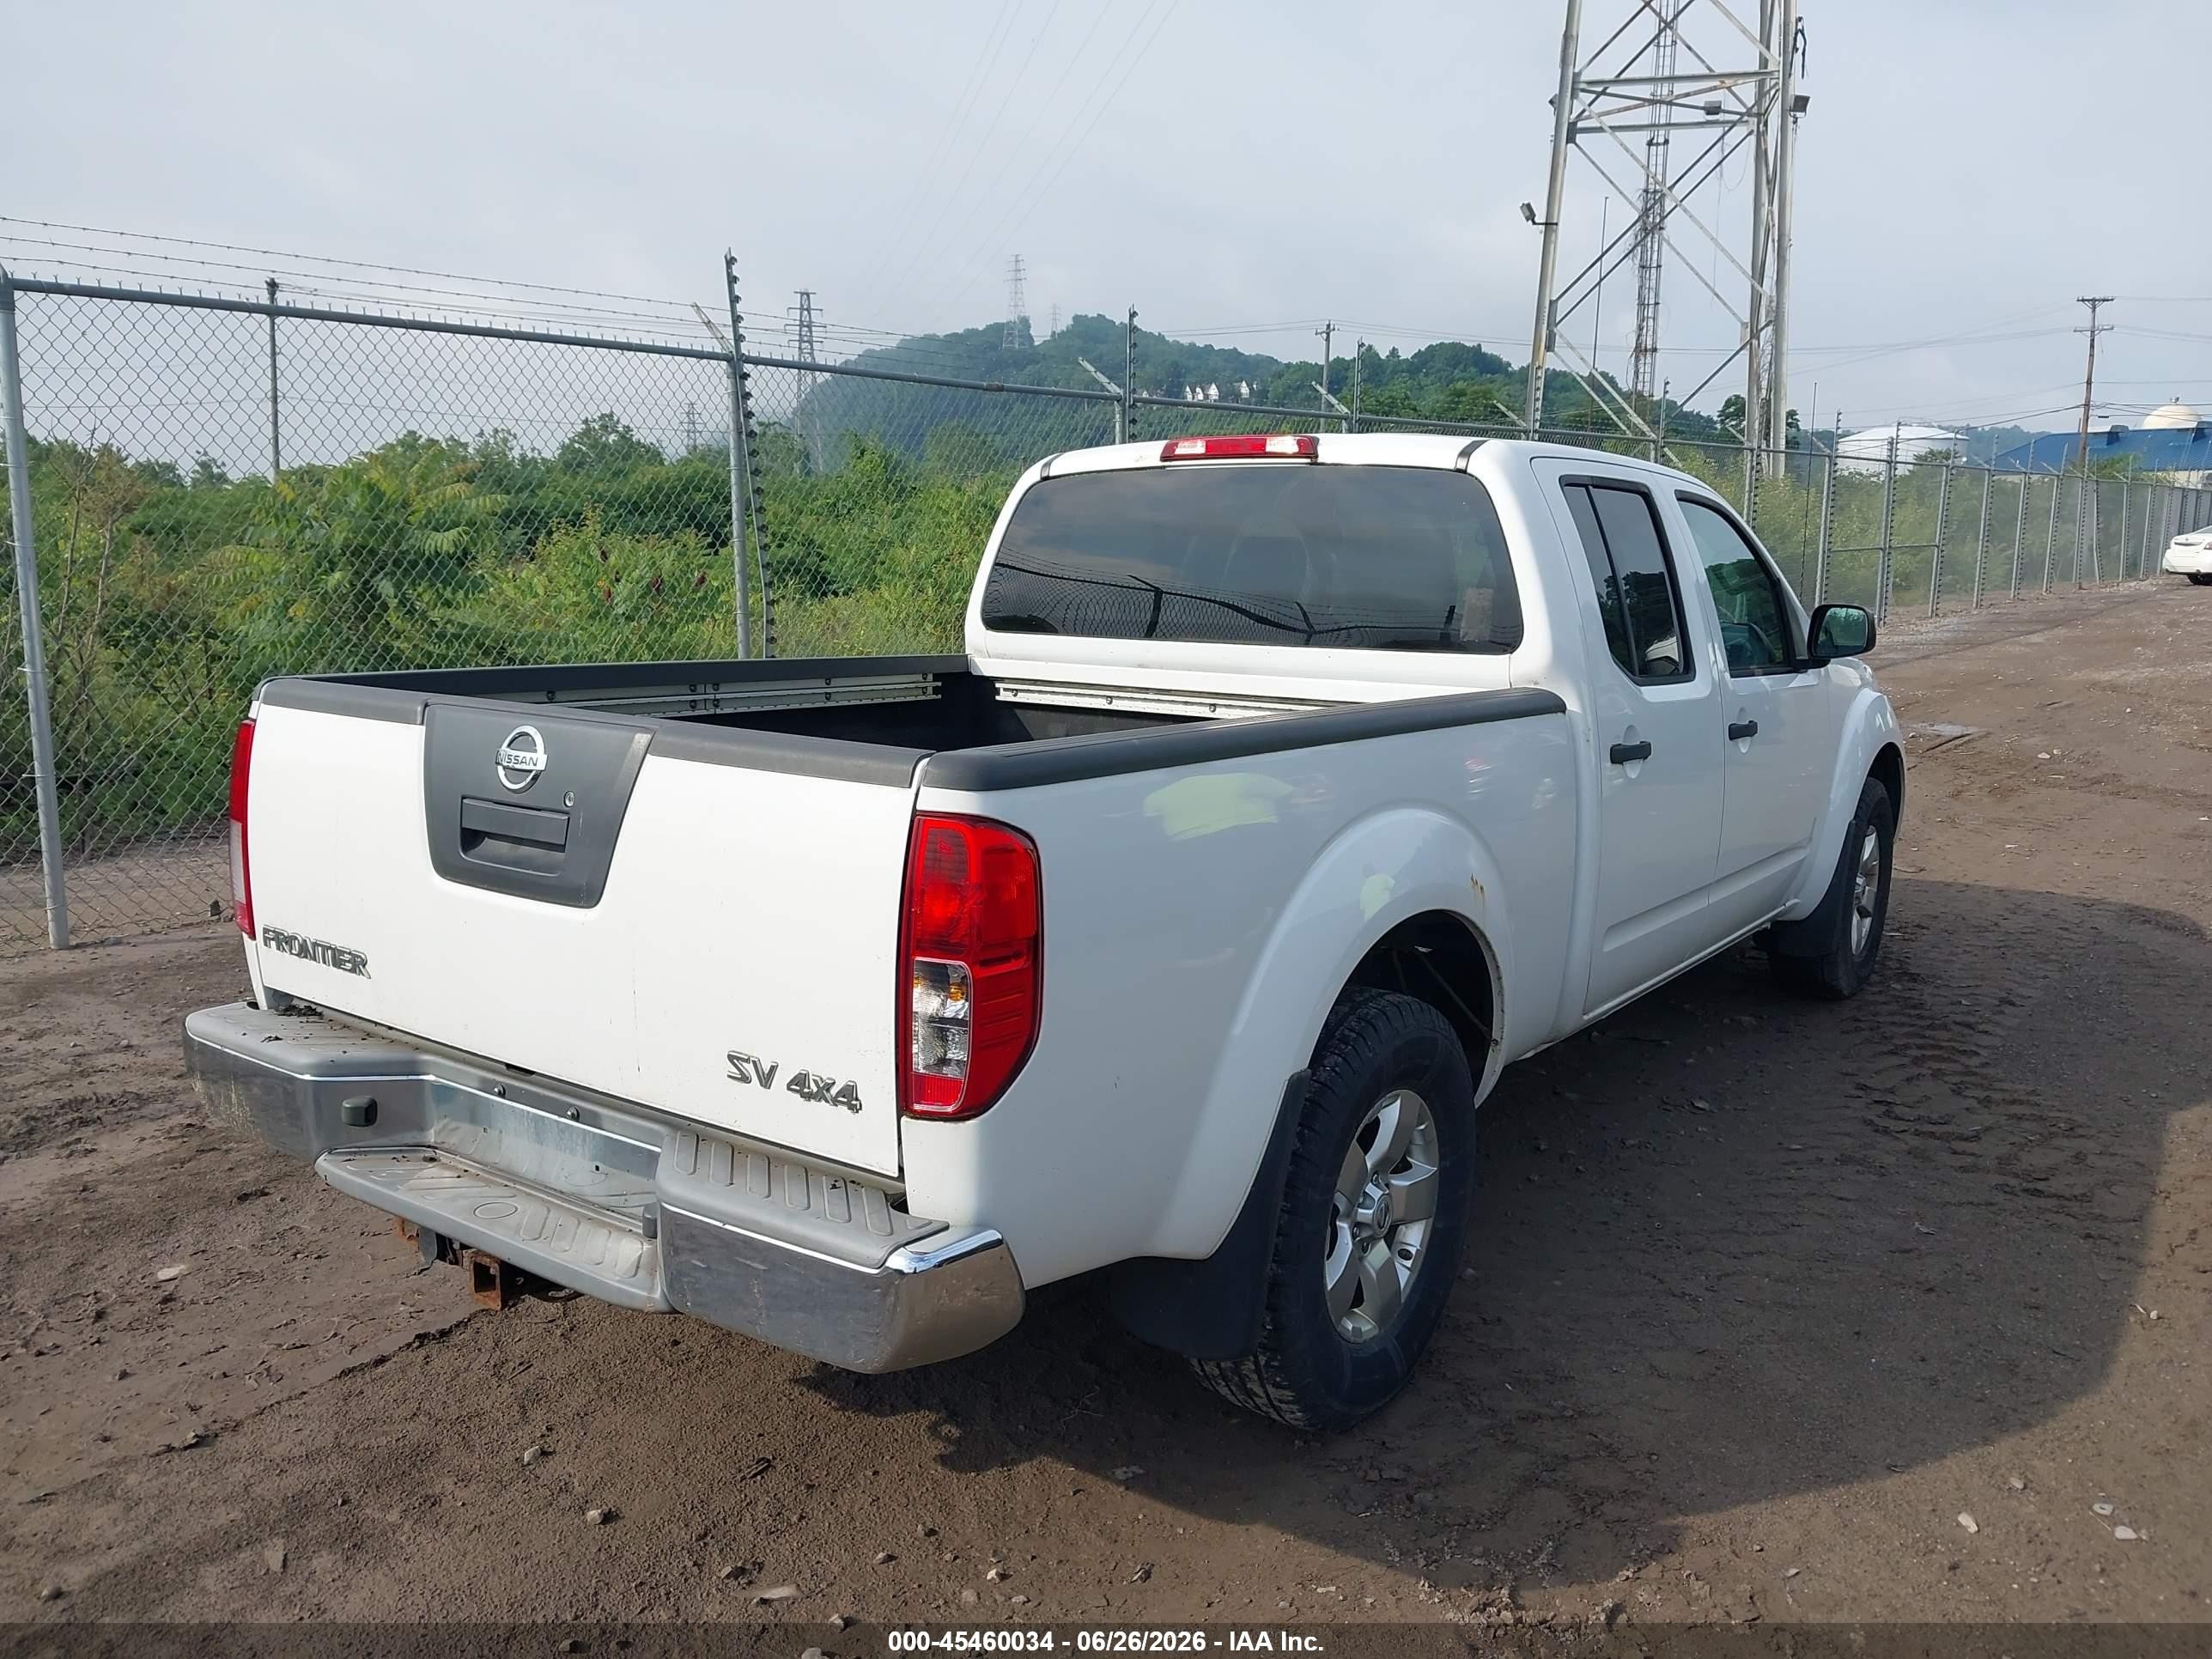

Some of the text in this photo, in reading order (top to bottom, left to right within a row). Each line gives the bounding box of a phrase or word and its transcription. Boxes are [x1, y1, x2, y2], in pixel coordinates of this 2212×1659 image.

[497, 750, 538, 767] NISSAN
[262, 924, 372, 979] FRONTIER
[726, 1050, 779, 1090] SV
